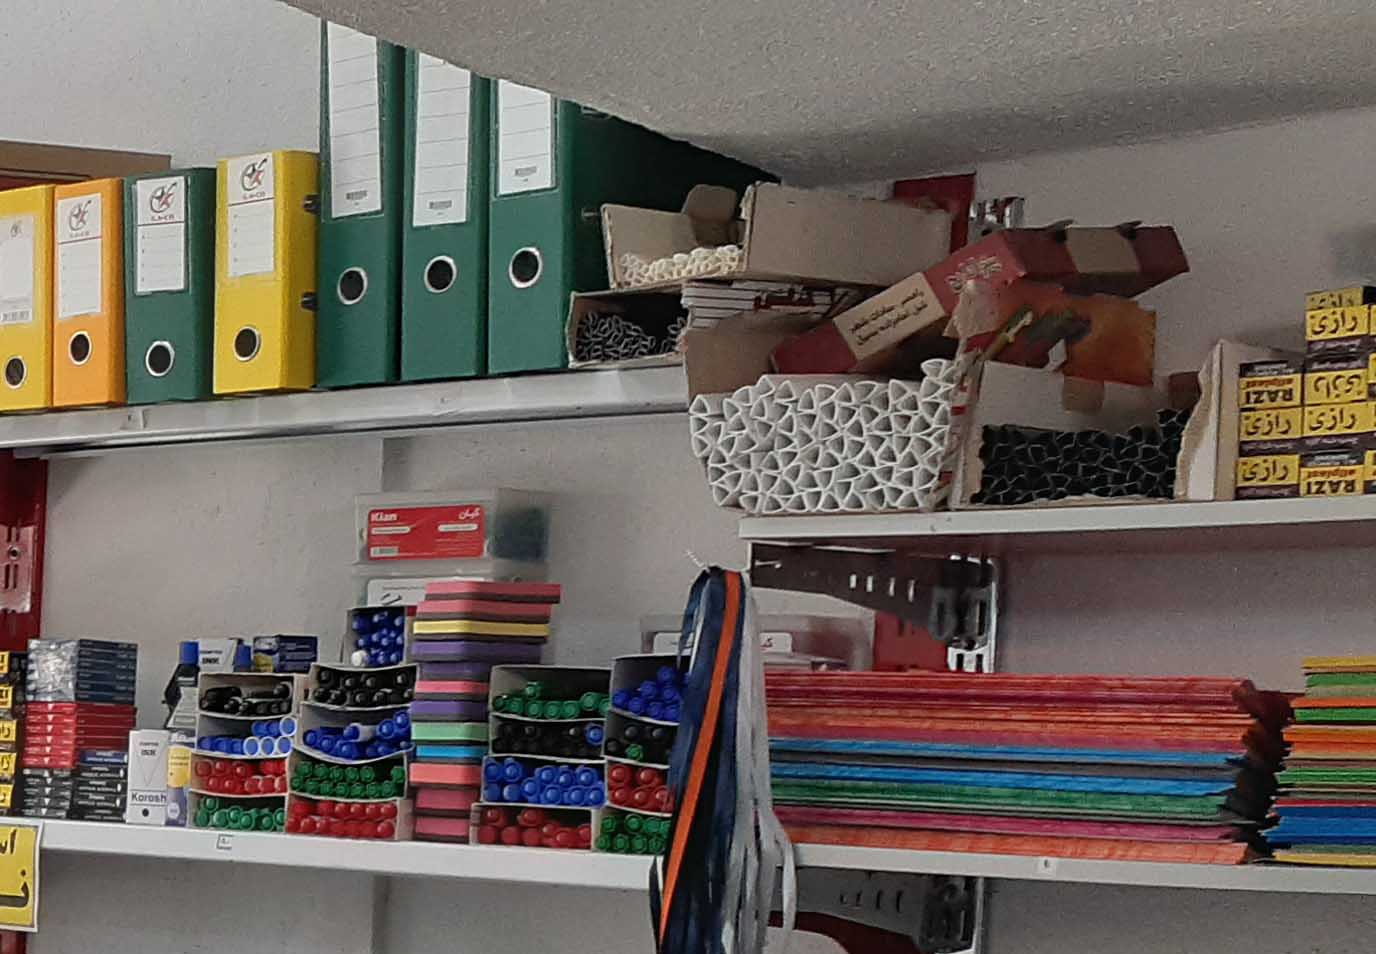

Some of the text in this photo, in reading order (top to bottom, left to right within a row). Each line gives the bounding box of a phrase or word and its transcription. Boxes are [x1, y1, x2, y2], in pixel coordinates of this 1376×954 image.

[1309, 311, 1359, 335] رازی
[1245, 387, 1294, 404] RAZI
[1244, 413, 1292, 436] رازی
[1308, 407, 1357, 432] رازی
[1241, 459, 1289, 482] رازی
[1306, 479, 1357, 495] RAZI
